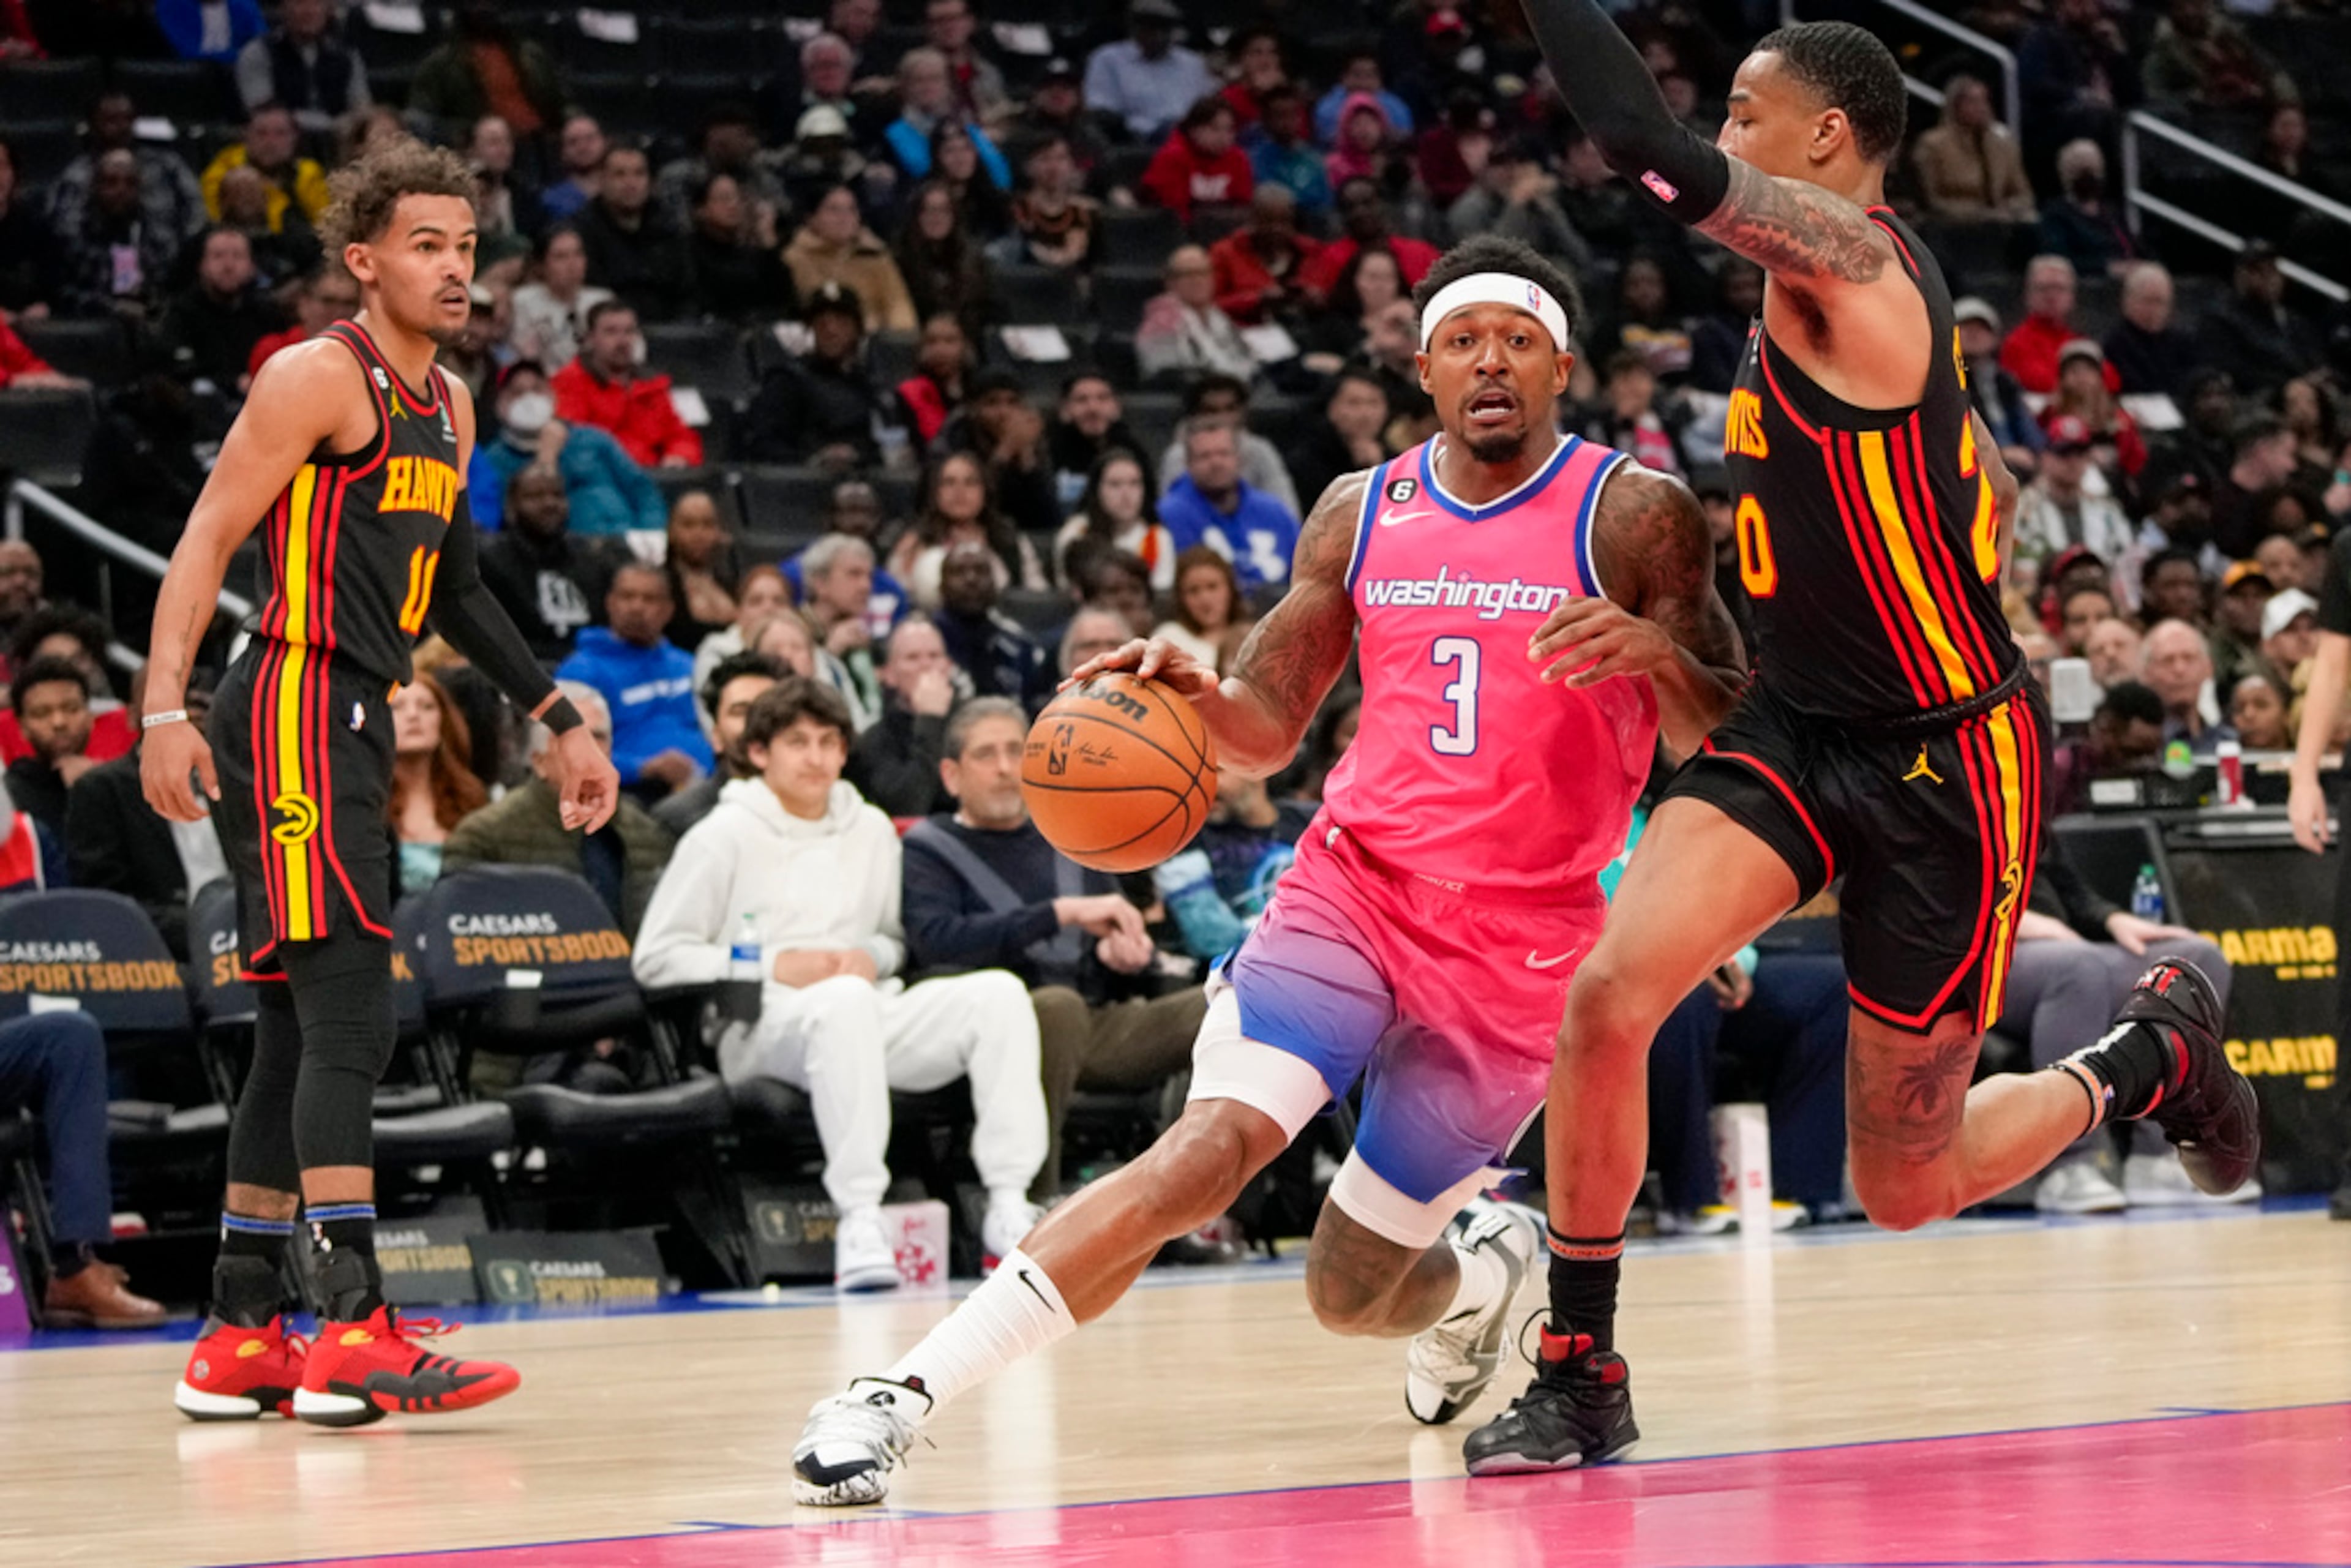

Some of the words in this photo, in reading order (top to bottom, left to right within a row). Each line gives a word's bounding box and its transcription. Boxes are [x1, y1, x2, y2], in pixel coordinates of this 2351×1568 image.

[1392, 480, 1413, 501] 6
[399, 543, 440, 637] 11
[1364, 564, 1570, 620] washington
[1430, 634, 1482, 756] 3
[449, 913, 557, 935] CAESARS
[0, 960, 183, 992] SPORTSBOOK
